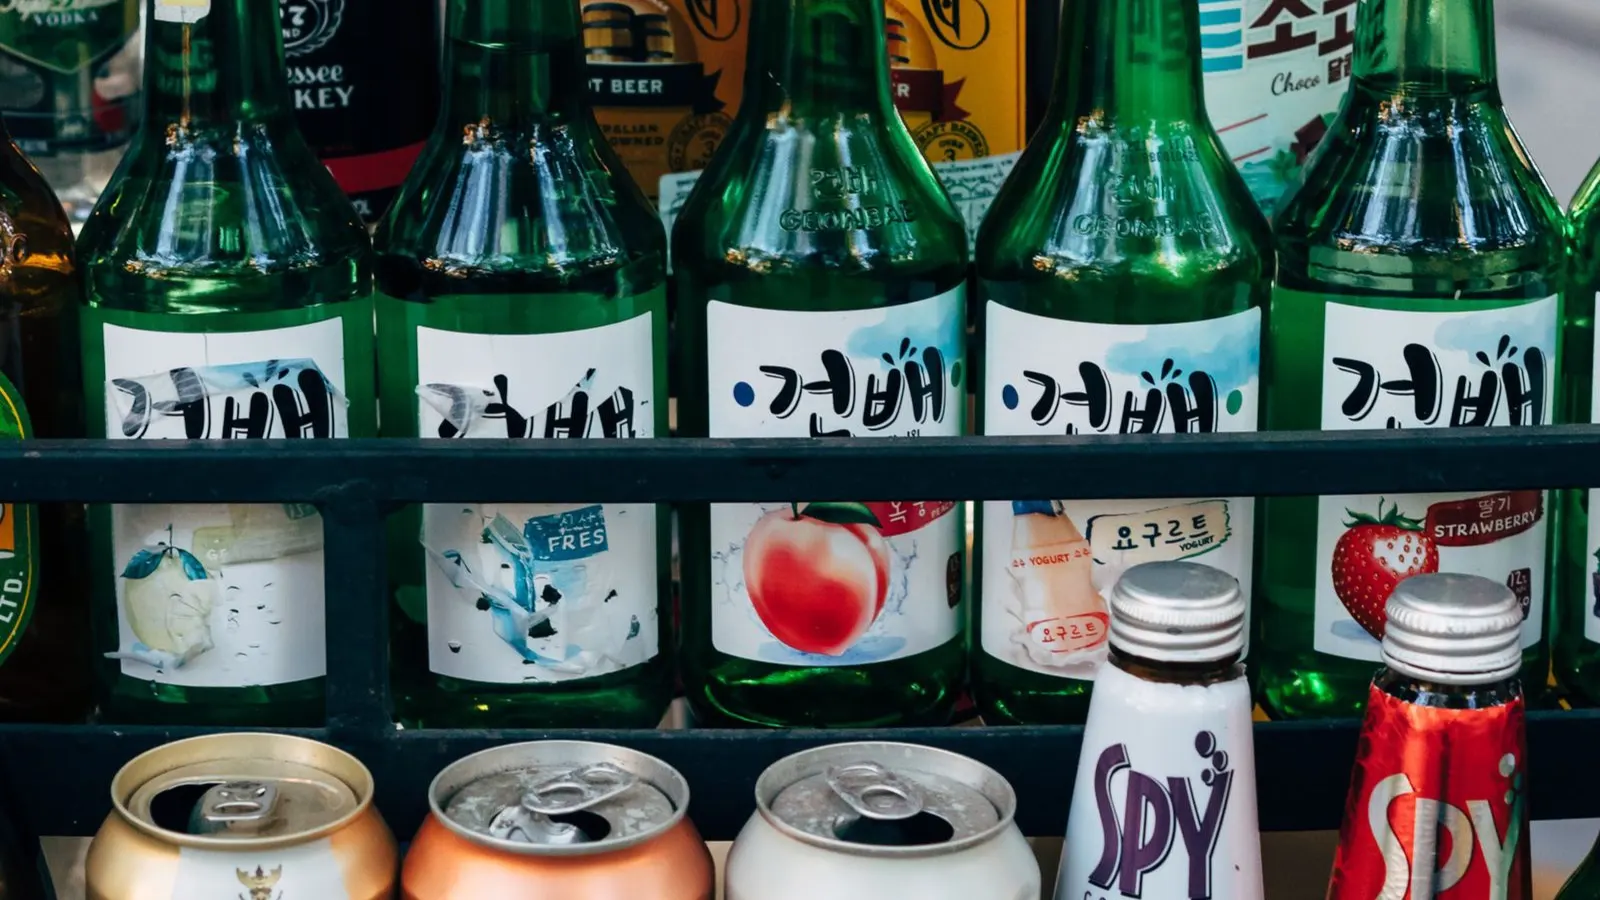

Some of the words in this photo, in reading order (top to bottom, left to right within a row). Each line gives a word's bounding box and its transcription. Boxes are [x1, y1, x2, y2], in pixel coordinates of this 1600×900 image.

[33, 11, 98, 27] VODKA
[611, 79, 663, 94] BEER
[1271, 72, 1320, 96] Choco
[759, 345, 947, 438] 건배
[1478, 496, 1511, 519] 딸기
[1112, 514, 1208, 551] 요구르트
[1434, 508, 1537, 538] STRAWBERRY
[548, 528, 604, 552] FRES
[1179, 534, 1215, 552] YOGURT
[1029, 553, 1071, 566] YOGURT
[0, 571, 23, 613] LTD.
[1041, 621, 1098, 643] 요구르트
[1088, 743, 1235, 900] SPY
[1368, 772, 1523, 900] SPY
